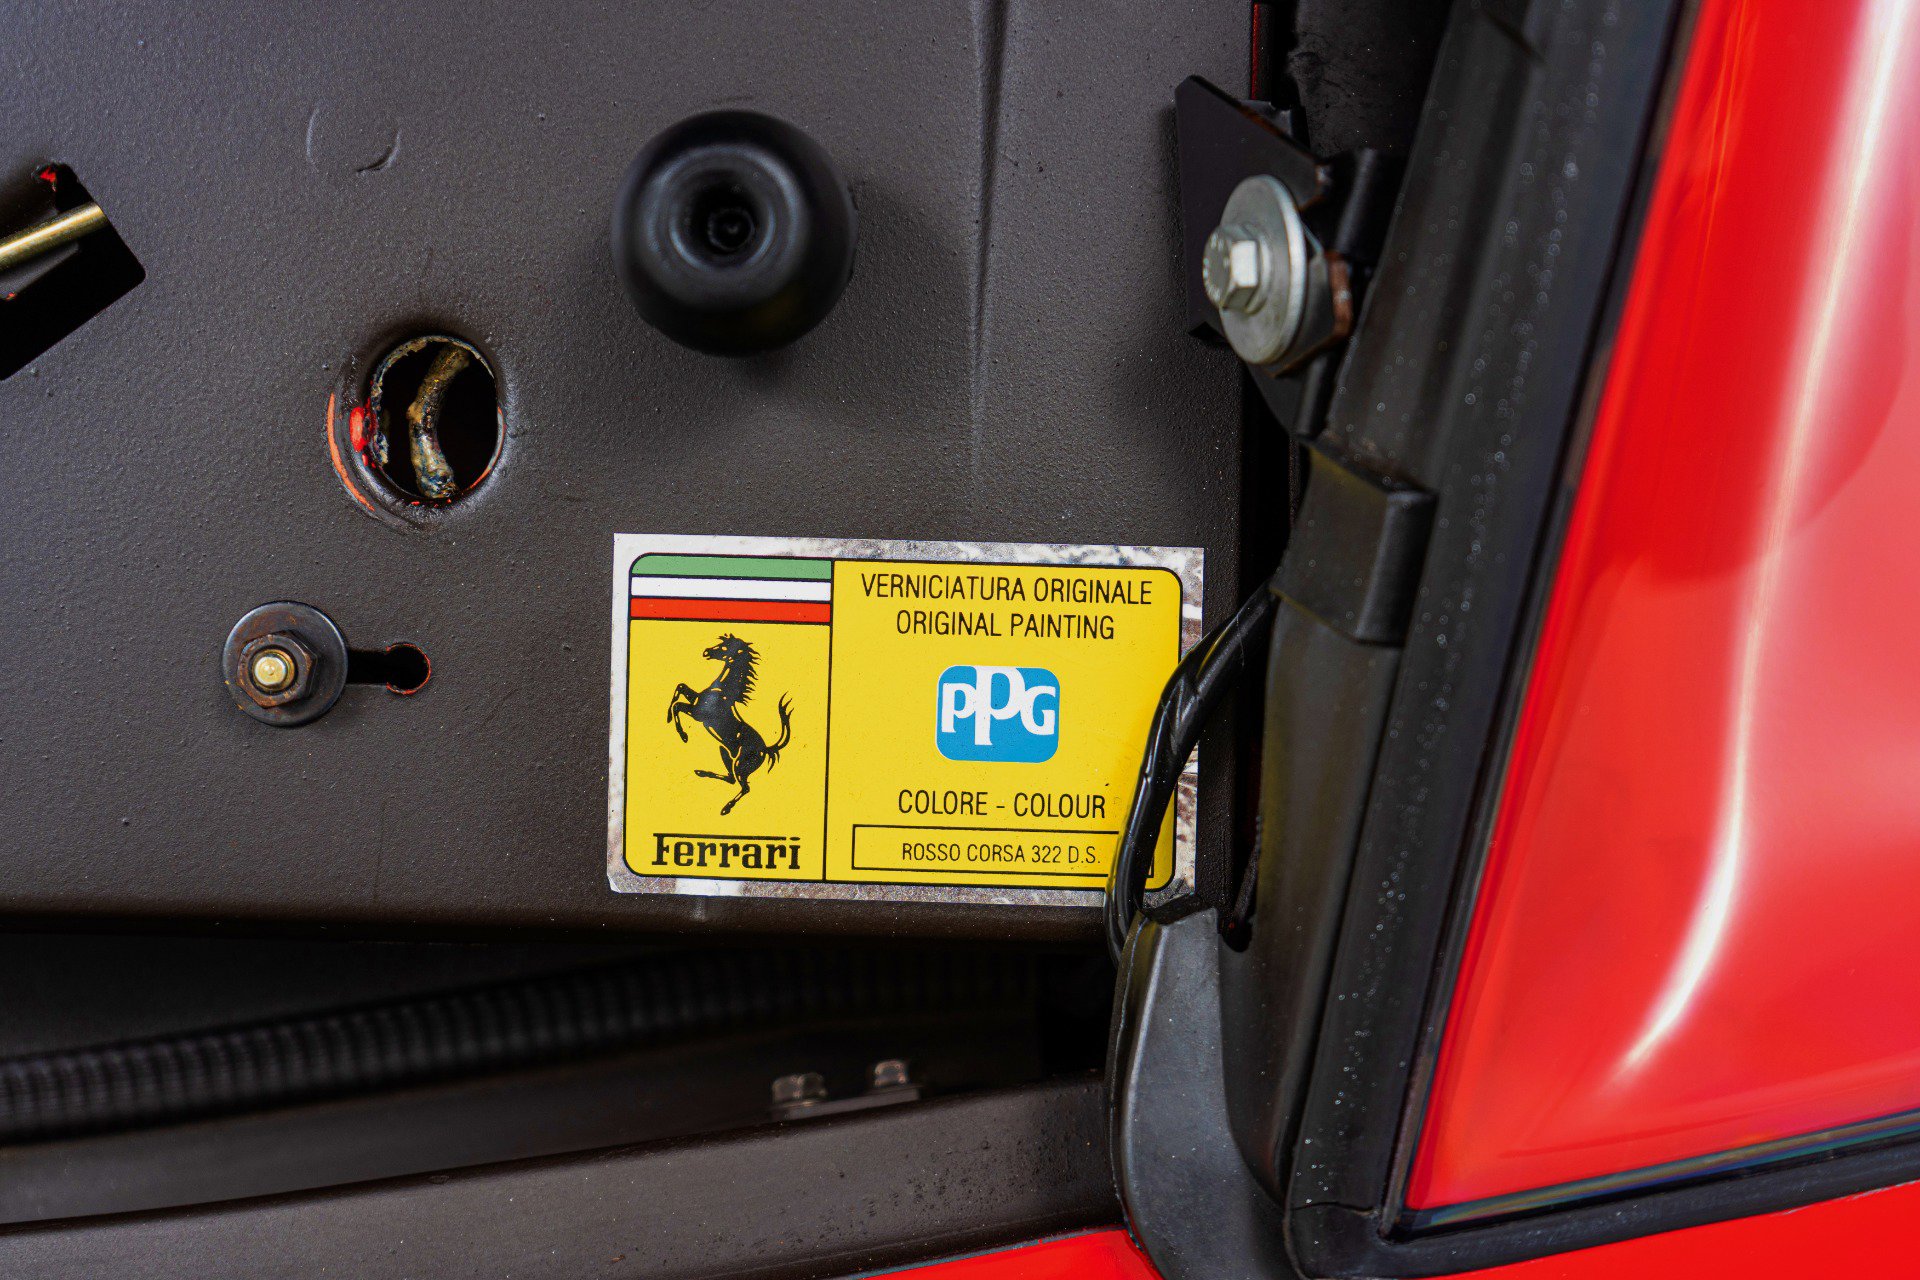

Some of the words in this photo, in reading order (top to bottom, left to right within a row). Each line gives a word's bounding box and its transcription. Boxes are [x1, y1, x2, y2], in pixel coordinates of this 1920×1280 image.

[861, 573, 1026, 602] VERNICIATURA
[1033, 577, 1153, 605] ORIGINALE
[896, 609, 1002, 637] ORIGINAL
[1010, 613, 1114, 640] PAINTING
[940, 665, 1056, 746] PPG
[898, 789, 989, 816] COLORE
[1013, 792, 1106, 819] COLOUR
[651, 832, 801, 870] Ferrari
[902, 842, 961, 862] ROSSO
[967, 843, 1026, 863] CORSA
[1031, 844, 1062, 864] 322
[1068, 845, 1101, 864] D.S.
